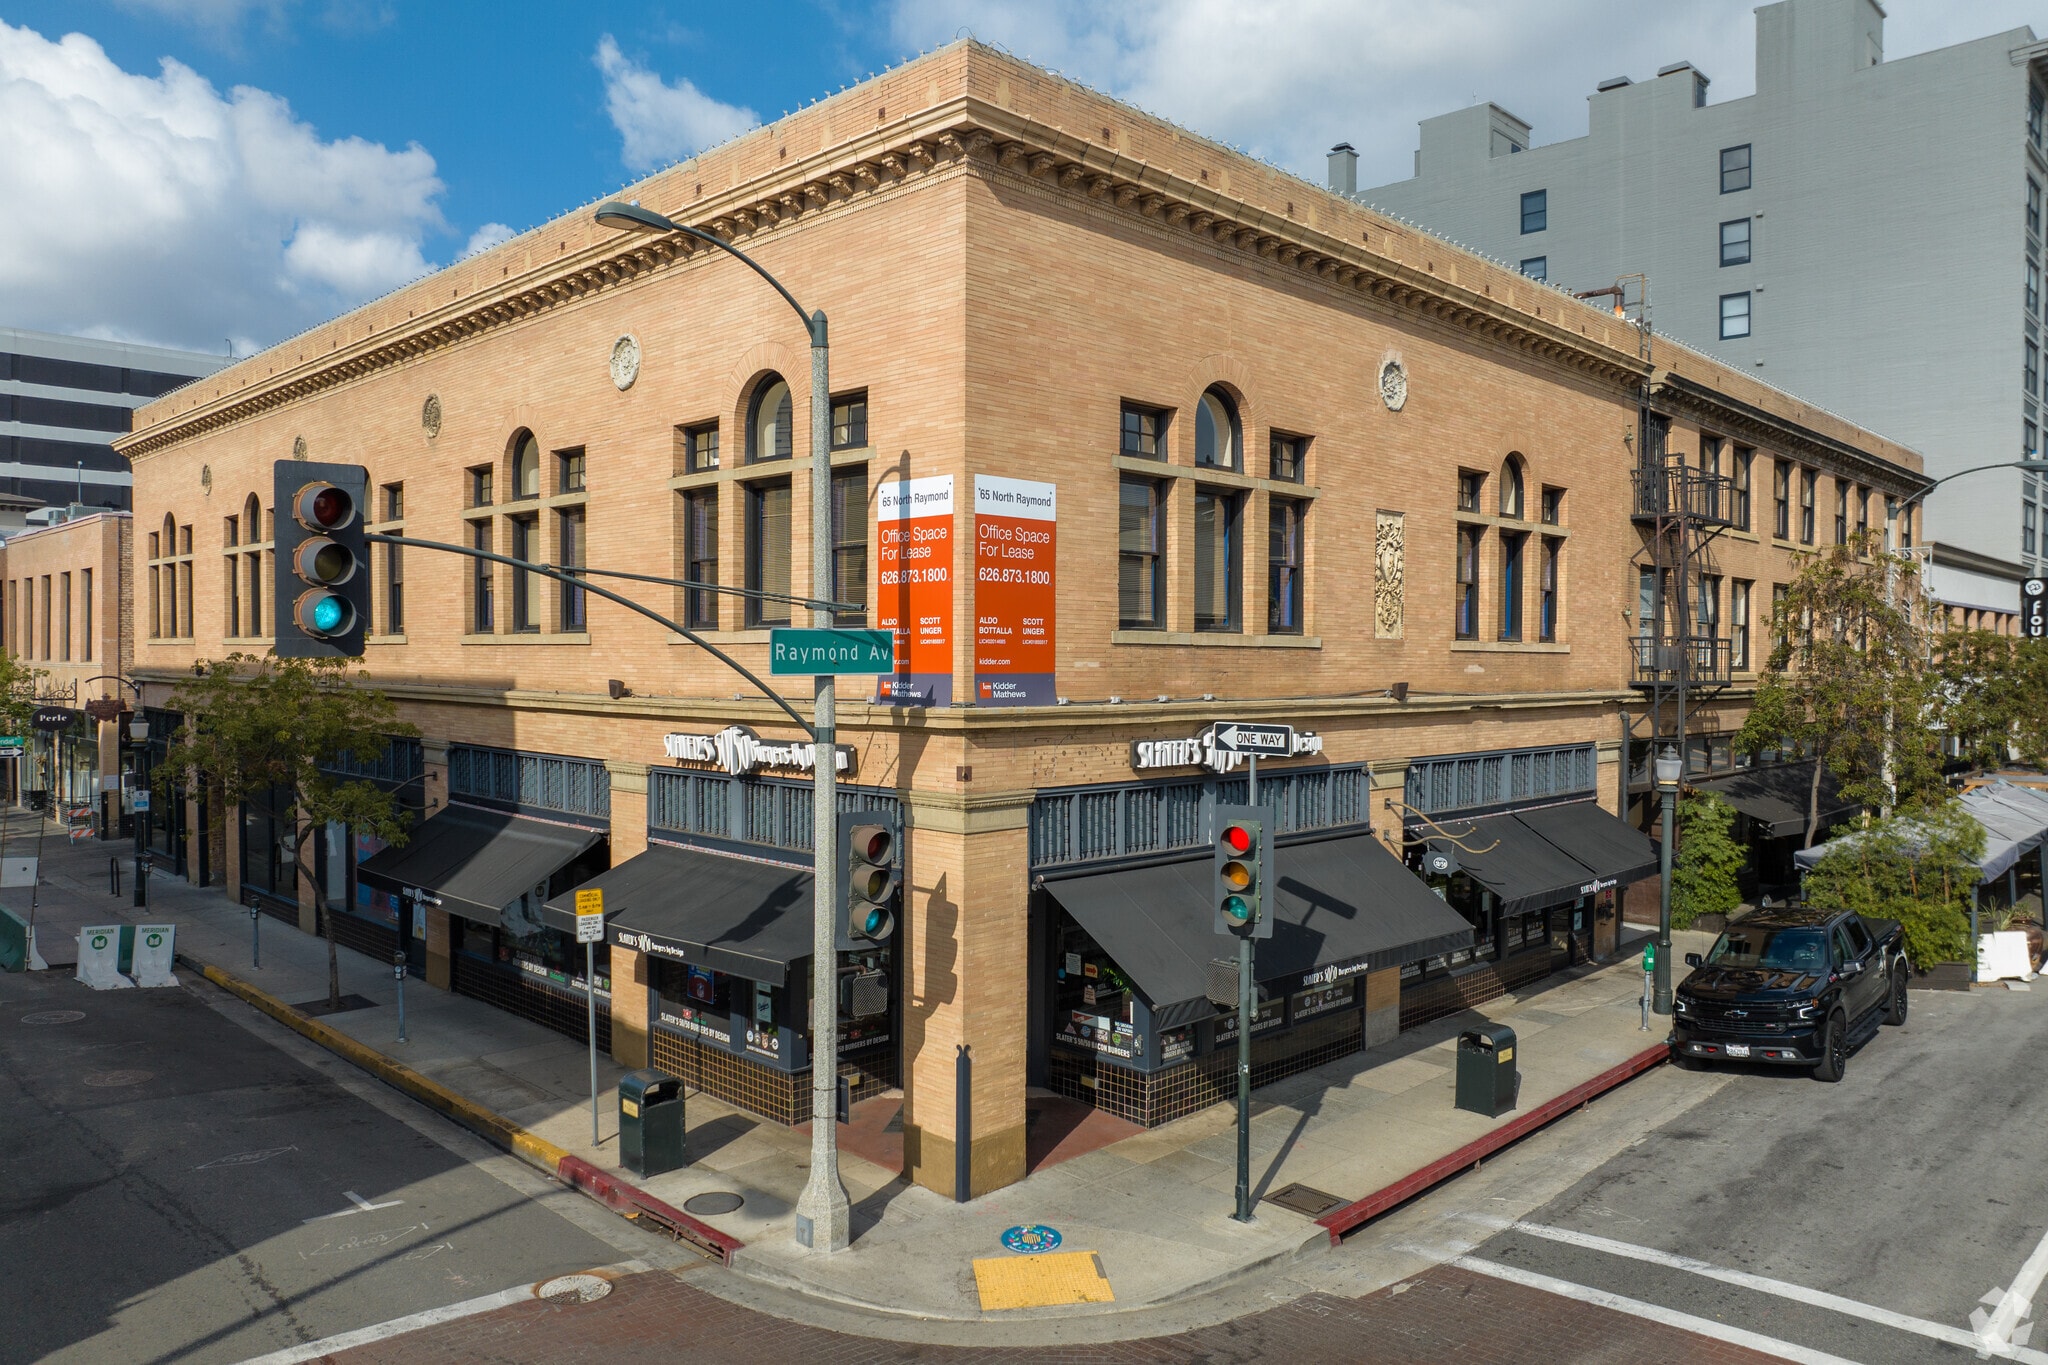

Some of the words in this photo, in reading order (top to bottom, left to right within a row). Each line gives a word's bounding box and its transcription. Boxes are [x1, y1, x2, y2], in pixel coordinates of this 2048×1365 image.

[882, 496, 891, 507] 65
[893, 494, 912, 506] North
[914, 490, 949, 504] Raymond
[980, 489, 990, 500] 65
[992, 490, 1014, 503] North
[1016, 493, 1051, 507] Raymond
[881, 529, 910, 544] Office
[912, 526, 947, 543] Space
[979, 523, 1012, 540] Office
[1015, 526, 1050, 545] Space
[881, 546, 898, 561] For
[900, 545, 931, 560] Lease
[979, 541, 999, 557] For
[1001, 543, 1034, 560] Lease
[881, 567, 947, 584] 626.873.1800
[979, 567, 1050, 585] 626.873.1800
[920, 617, 941, 625] SCOTT
[979, 616, 998, 624] ALDO
[1022, 617, 1044, 625] SCOTT
[979, 626, 1013, 635] BOTTALLA
[775, 643, 858, 665] Raymond
[869, 644, 889, 661] Av
[892, 681, 914, 689] Kidder
[992, 682, 1016, 690] Kidder
[891, 690, 922, 698] Mathews
[993, 690, 1027, 698] Mathews
[40, 714, 68, 722] Perle
[1236, 733, 1257, 744] ONE
[1260, 733, 1283, 746] WAY
[663, 734, 716, 762] SLATER'S
[1136, 738, 1202, 768] SLATER'S
[86, 928, 115, 936] MERIDIAN
[661, 1012, 679, 1026] SLATER'S
[715, 1030, 731, 1043] DESIGN
[1268, 1017, 1282, 1027] DESIGN
[845, 1040, 866, 1051] BURGERS
[866, 1038, 873, 1046] BY
[872, 1034, 890, 1045] DESIGN
[1056, 1033, 1077, 1044] SLATER'S
[1107, 1046, 1131, 1058] BURGERS
